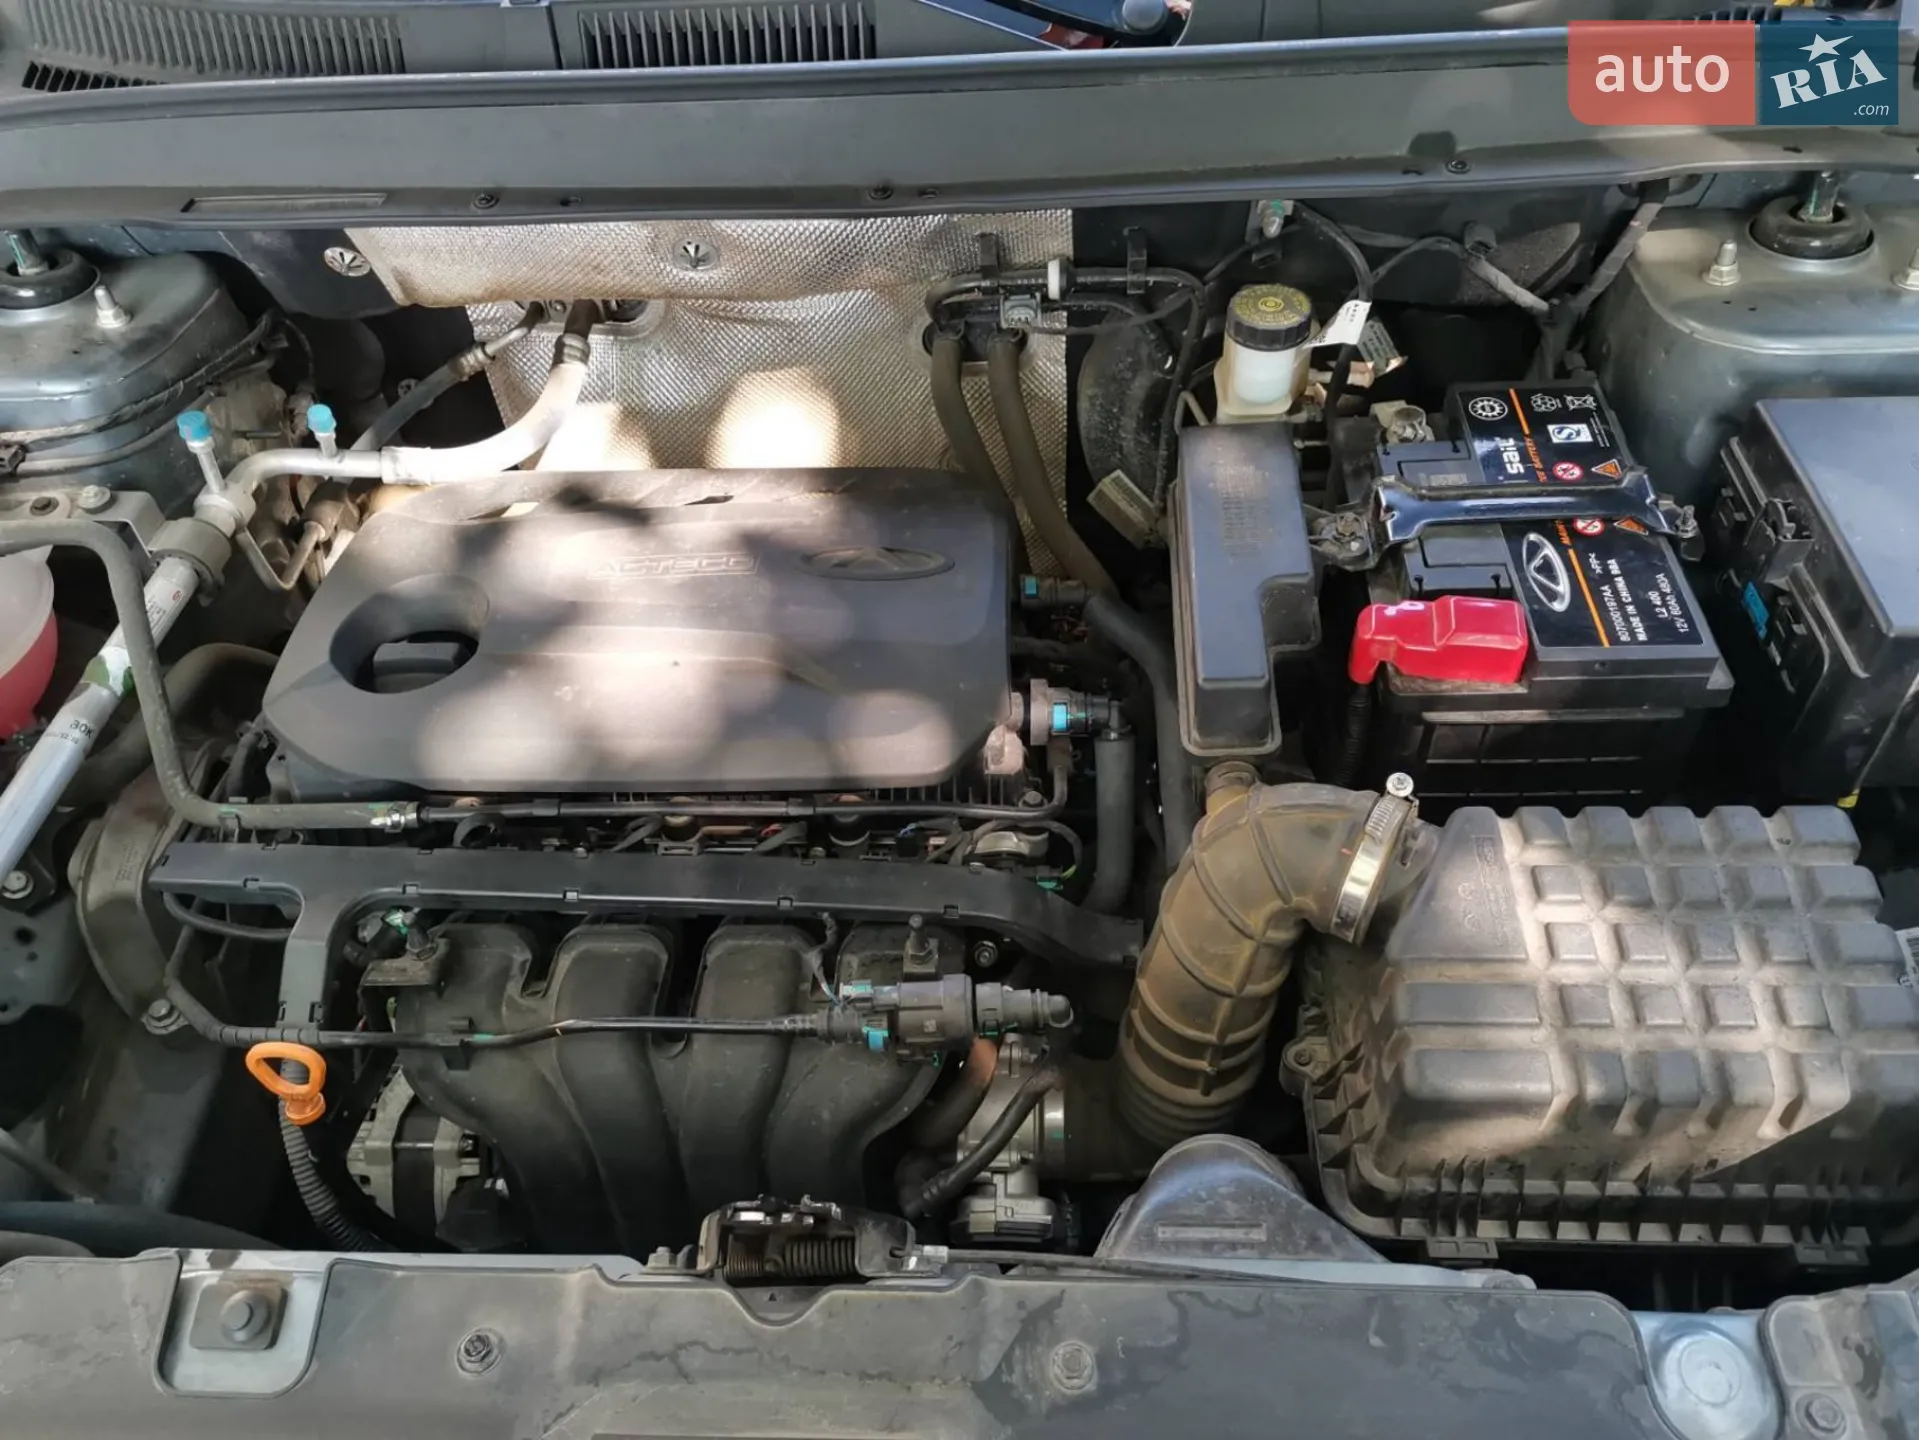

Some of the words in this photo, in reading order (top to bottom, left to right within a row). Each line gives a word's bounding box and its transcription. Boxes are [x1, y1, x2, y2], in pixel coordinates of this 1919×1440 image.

[1614, 576, 1632, 603] CHINA
[1625, 605, 1637, 614] IN
[1629, 616, 1648, 641] MADE
